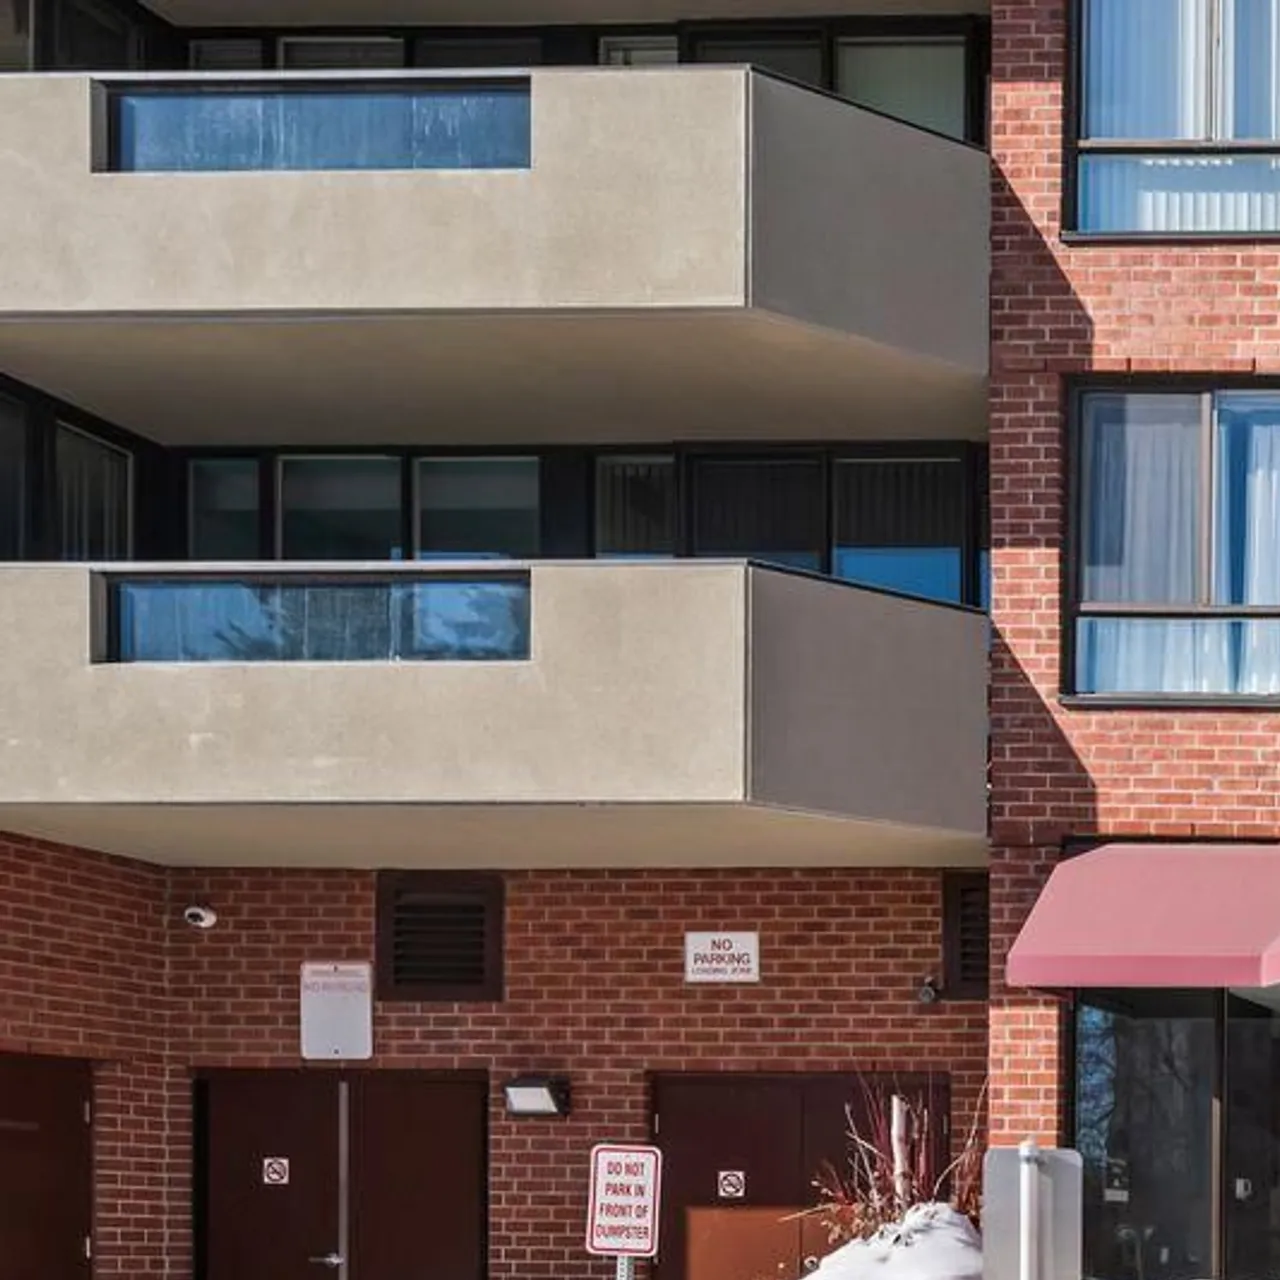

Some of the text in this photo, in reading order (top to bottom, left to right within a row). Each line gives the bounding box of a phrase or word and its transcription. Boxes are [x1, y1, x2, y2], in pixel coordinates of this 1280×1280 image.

[710, 938, 733, 951] NO
[693, 952, 751, 965] PARKING
[606, 1161, 645, 1177] DO NOT
[604, 1182, 646, 1197] PARK IN
[600, 1202, 649, 1218] FRONT OF
[595, 1224, 649, 1240] DUMPSTER
